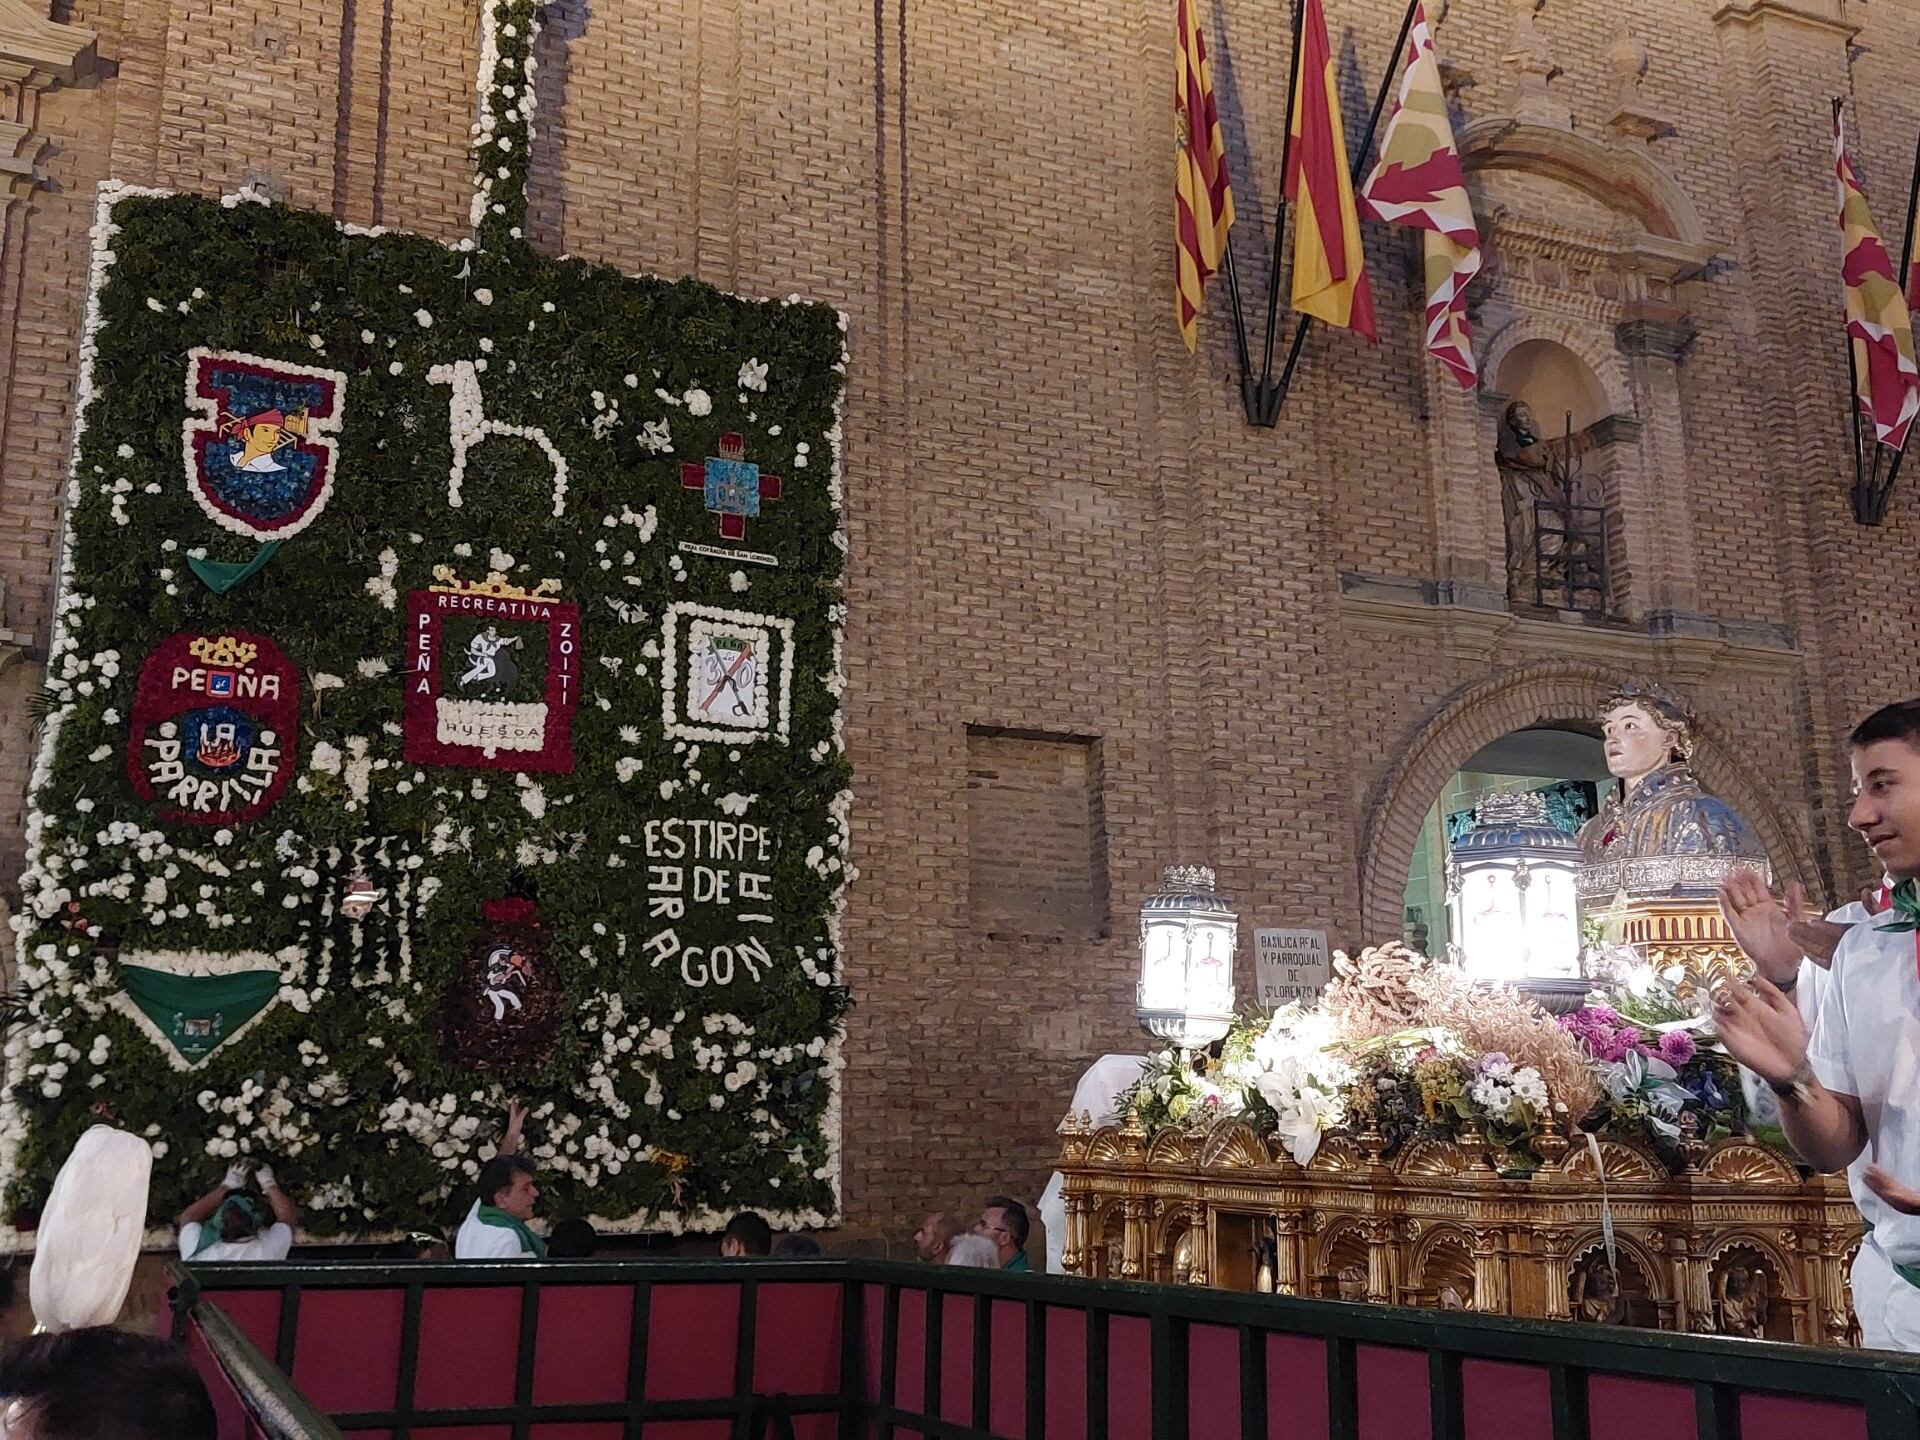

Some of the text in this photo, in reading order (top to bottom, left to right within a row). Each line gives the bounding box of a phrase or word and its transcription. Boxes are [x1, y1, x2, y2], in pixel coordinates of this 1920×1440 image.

[438, 595, 551, 618] RECREATIVA
[416, 613, 431, 695] PEÑA
[558, 623, 574, 705] ZOITI
[200, 722, 236, 748] LA
[643, 817, 771, 861] ESTIRPE
[693, 865, 731, 905] DE
[1262, 951, 1268, 966] Y
[1287, 969, 1300, 982] DE
